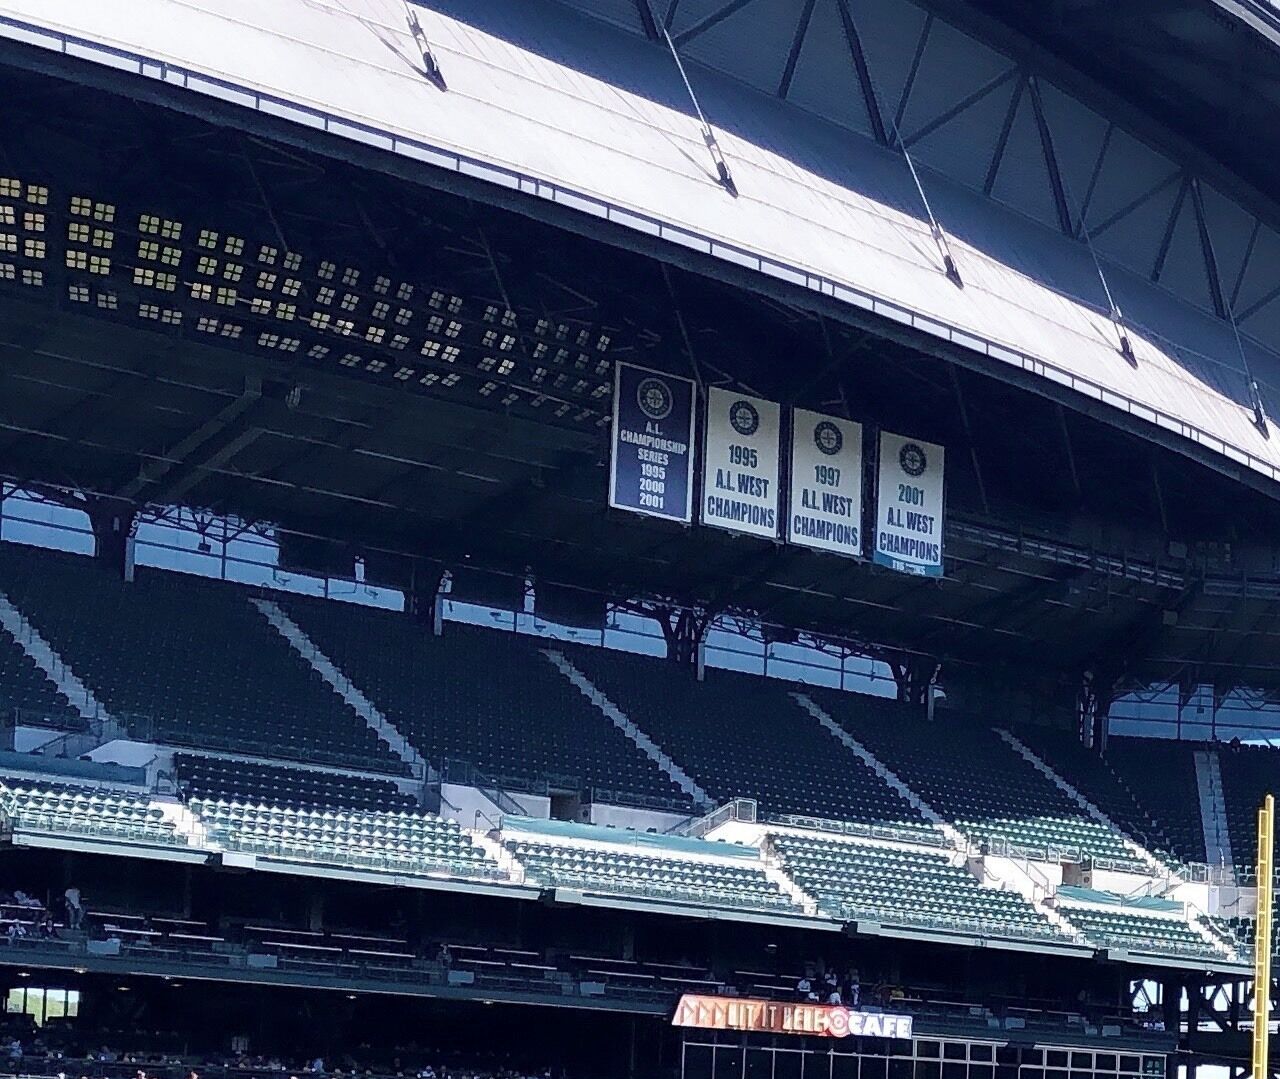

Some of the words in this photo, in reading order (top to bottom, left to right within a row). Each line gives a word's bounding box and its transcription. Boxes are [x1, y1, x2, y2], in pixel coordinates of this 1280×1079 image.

[645, 421, 664, 435] A.L.
[620, 429, 687, 455] CHAMPIONSHIP
[637, 447, 669, 466] SERIES
[728, 444, 758, 469] 1995
[640, 463, 666, 479] 1995
[715, 468, 735, 492] A.L.
[737, 473, 769, 499] WEST
[814, 464, 841, 487] 1997
[639, 477, 665, 494] 2000
[898, 484, 925, 507] 2001
[639, 492, 664, 509] 2001
[707, 495, 775, 529] CHAMPIONS
[802, 488, 820, 511] A.L.
[822, 492, 853, 517] WEST
[793, 515, 858, 547] CHAMPIONS
[887, 507, 905, 528] A.L.
[906, 511, 935, 535] WEST
[879, 532, 940, 563] CHAMPIONS
